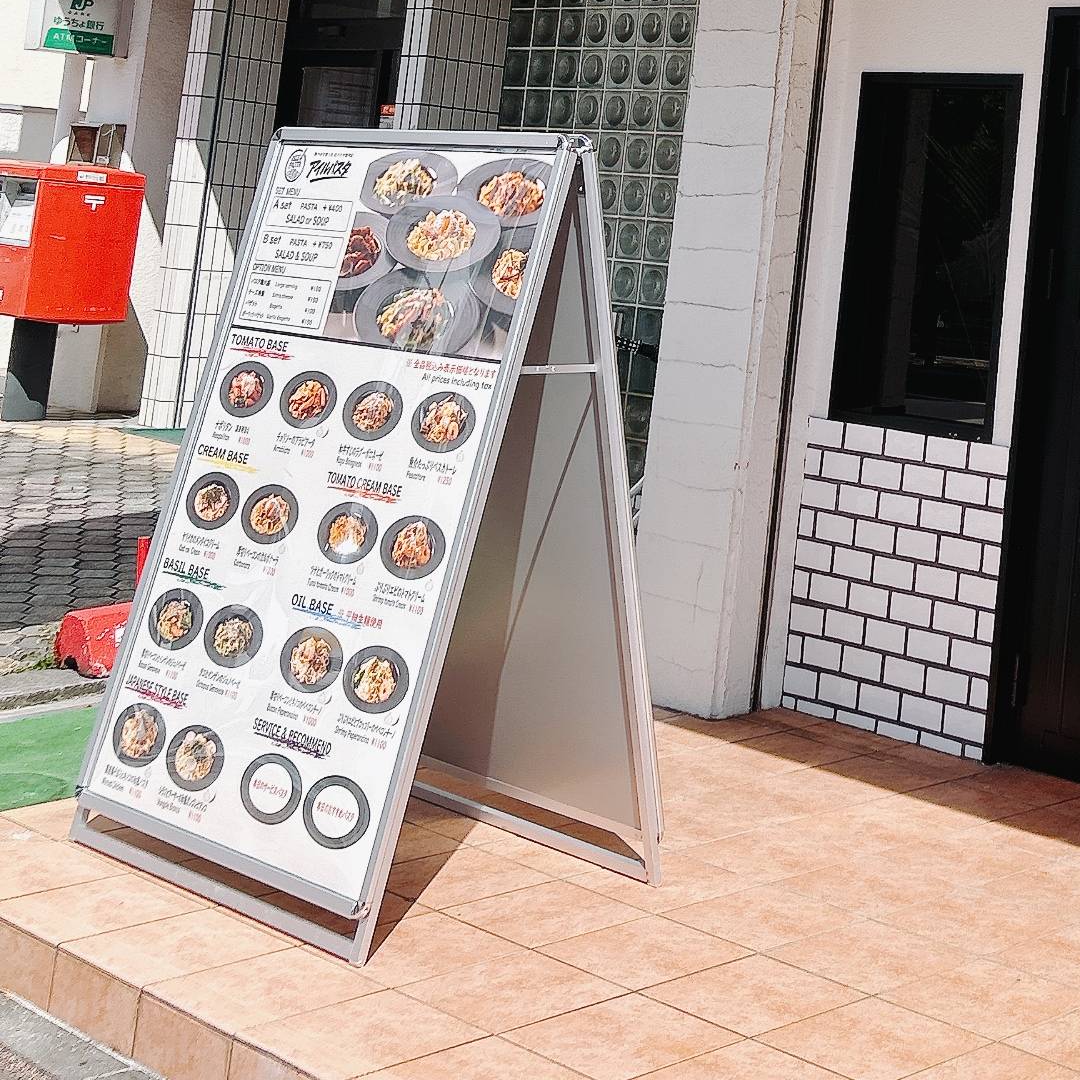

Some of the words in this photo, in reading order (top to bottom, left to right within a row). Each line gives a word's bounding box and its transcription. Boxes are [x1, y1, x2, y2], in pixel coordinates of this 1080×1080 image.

[53, 16, 105, 31] ゆうちょ銀行
[272, 198, 281, 209] A
[279, 200, 293, 210] set
[298, 201, 319, 210] PASTA
[284, 212, 306, 225] SALAD
[310, 215, 330, 227] SOUP
[268, 234, 282, 245] set
[288, 237, 309, 247] PASTA
[273, 248, 295, 260] SALAD
[299, 251, 319, 263] SOUP
[231, 334, 266, 349] TOMATO
[266, 338, 289, 352] BASE
[430, 375, 450, 385] prices
[451, 377, 480, 390] including
[197, 444, 226, 460] CREAM
[227, 451, 249, 465] BASE
[327, 471, 356, 489] TOMATO
[357, 477, 381, 493] CREAM
[382, 483, 403, 497] BASE
[163, 557, 186, 573] BASIL
[188, 564, 210, 579] BASE
[291, 593, 307, 608] OIL
[309, 598, 334, 615] BASE
[126, 673, 154, 691] JAPANESE
[155, 683, 172, 700] STYLE
[172, 690, 189, 706] BASE
[253, 717, 281, 738] SERVICE
[288, 729, 332, 756] RECOMMEND
